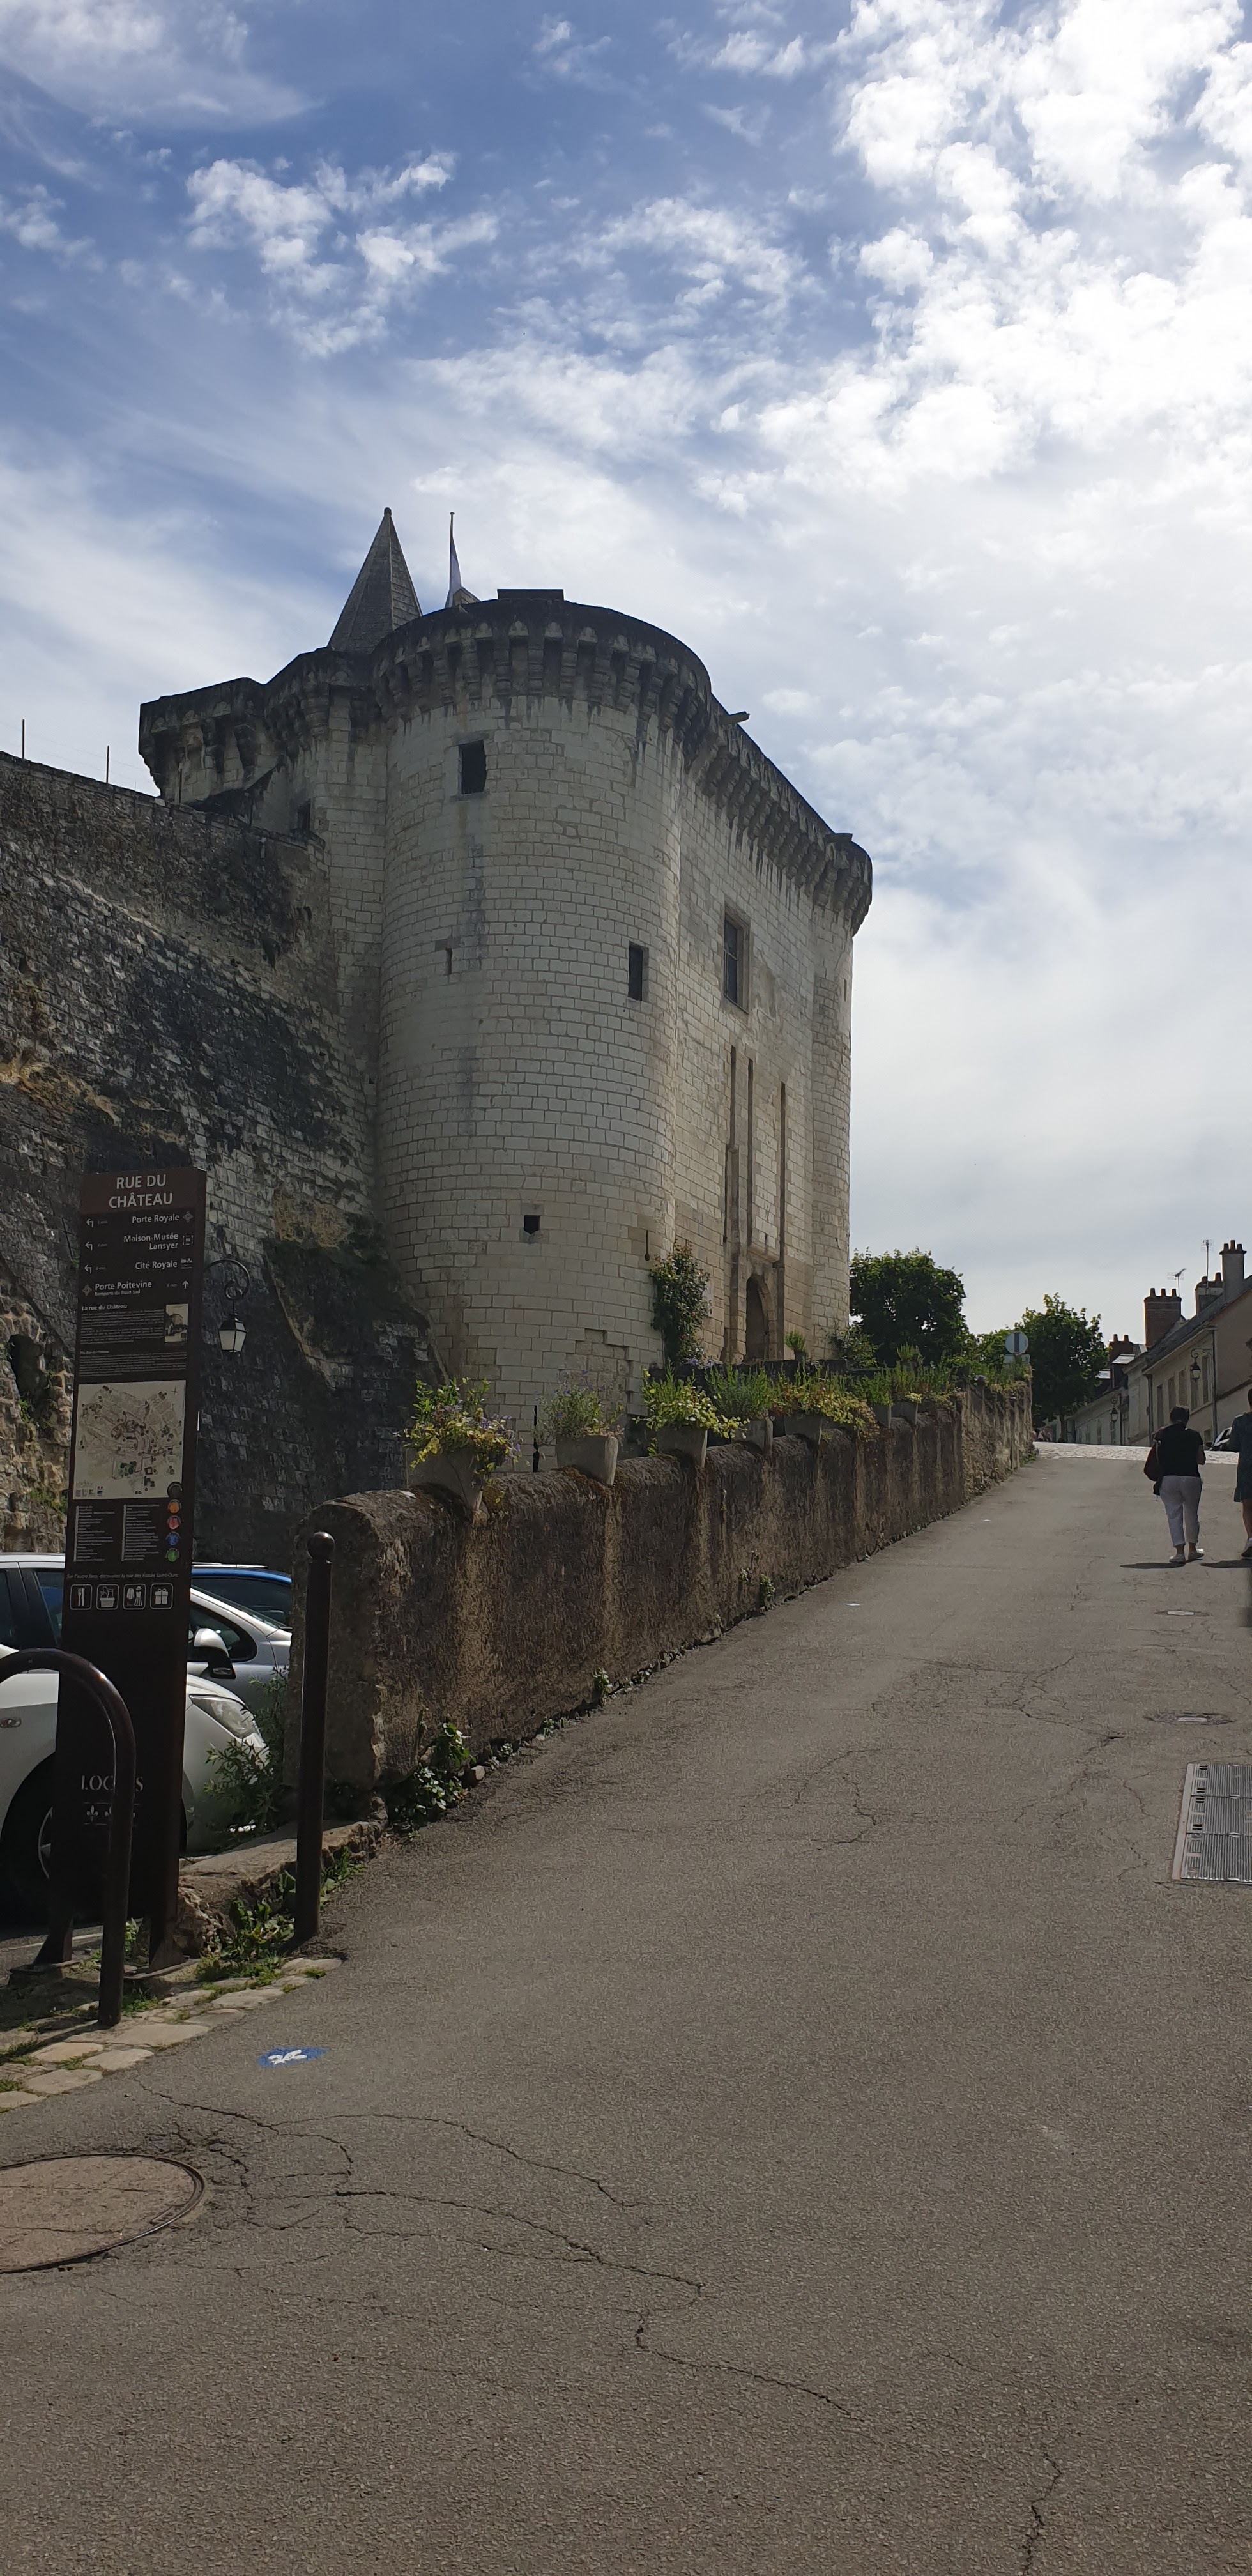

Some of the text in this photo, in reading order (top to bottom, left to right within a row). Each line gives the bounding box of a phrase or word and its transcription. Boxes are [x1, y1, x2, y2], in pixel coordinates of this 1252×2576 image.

[116, 1174, 166, 1189] RUE DU
[109, 1192, 173, 1209] CHÂTEAU
[132, 1213, 180, 1223] Porte Royale
[123, 1232, 179, 1243] Maison-Musée
[149, 1242, 179, 1251] Lansyer
[135, 1260, 178, 1270] Cité Royale
[95, 1280, 153, 1291] Porte Poitevine
[81, 1775, 144, 1792] LOCS
